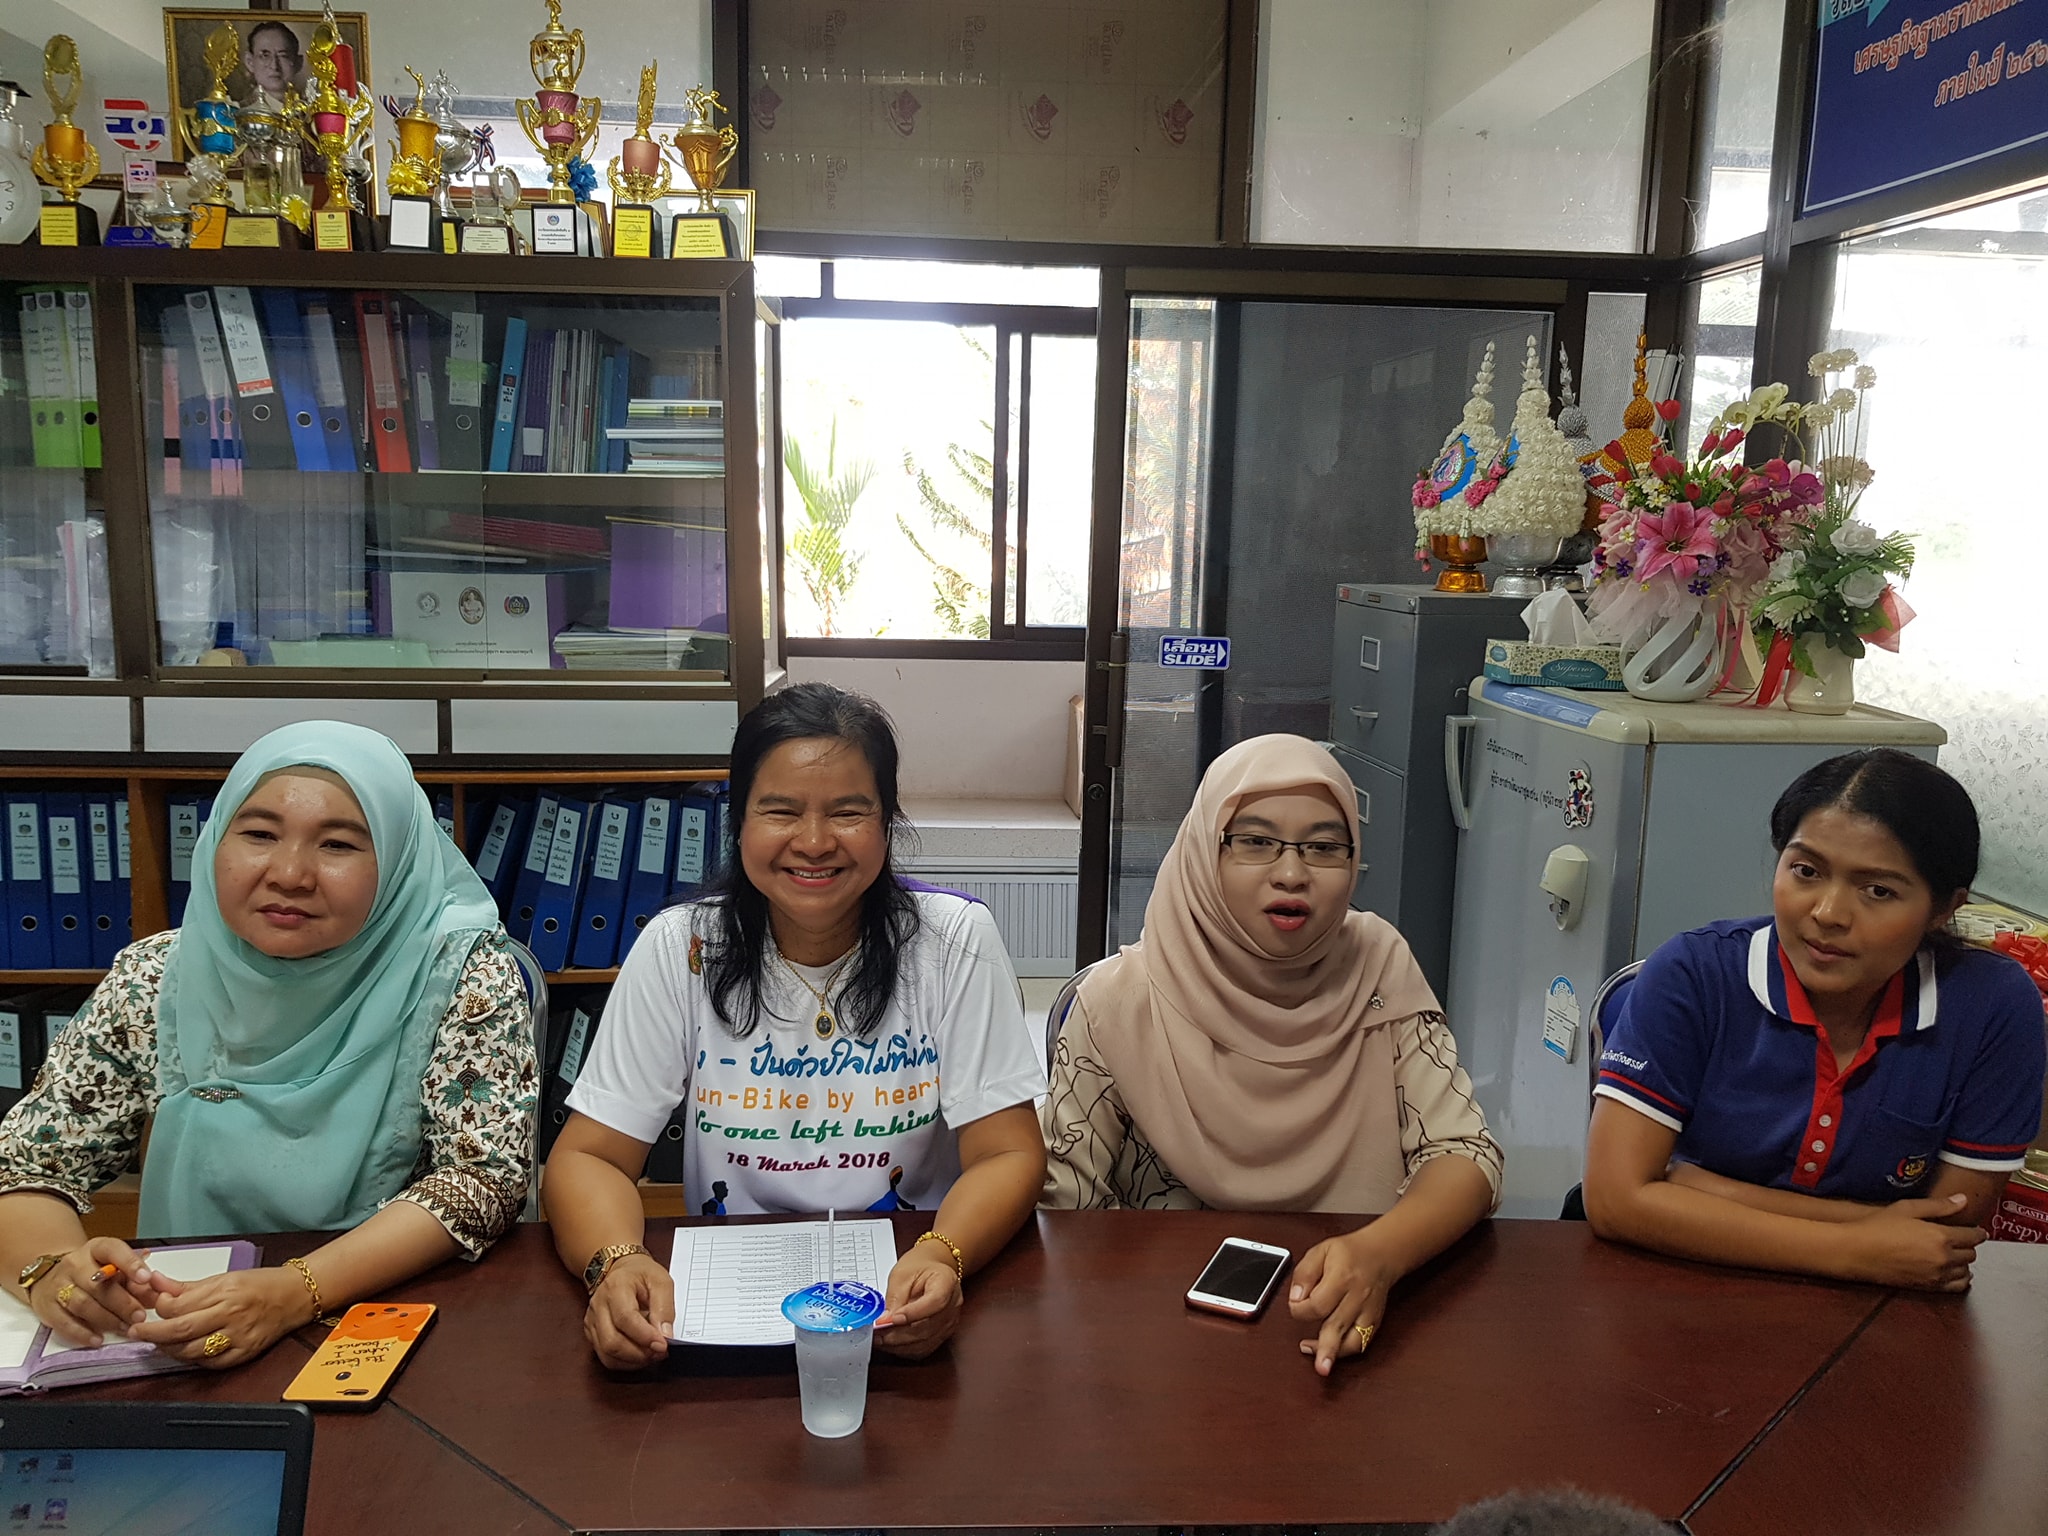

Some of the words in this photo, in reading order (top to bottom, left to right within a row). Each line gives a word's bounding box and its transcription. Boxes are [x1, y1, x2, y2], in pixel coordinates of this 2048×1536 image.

[2006, 39, 2048, 80] ๒๕๖
[5, 201, 15, 211] 3
[1163, 638, 1216, 654] เลื่อน
[1163, 653, 1217, 666] SLIDE
[1550, 661, 1597, 679] Superior
[697, 1086, 810, 1110] un-Bike
[827, 1087, 855, 1113] by
[723, 1124, 781, 1140] one
[790, 1118, 844, 1144] left
[727, 1152, 749, 1167] 18
[756, 1154, 831, 1172] March
[837, 1151, 891, 1169] 2018
[1992, 1214, 2042, 1244] Crispy
[334, 1340, 380, 1349] bounce
